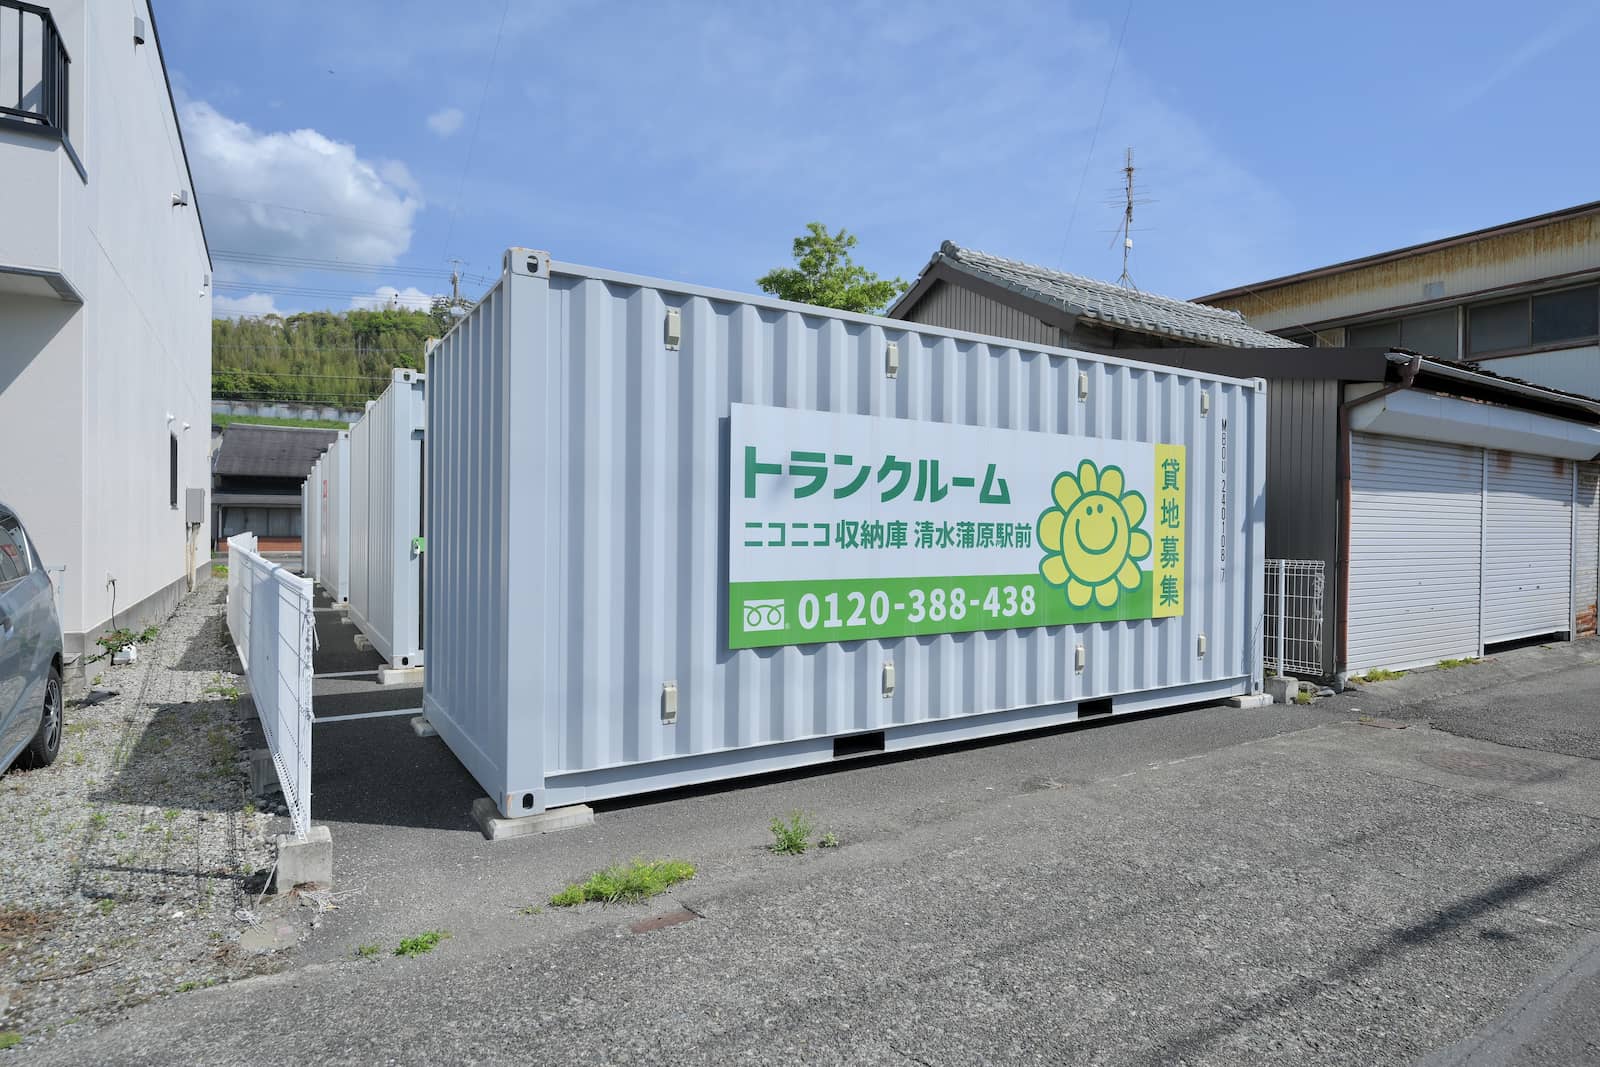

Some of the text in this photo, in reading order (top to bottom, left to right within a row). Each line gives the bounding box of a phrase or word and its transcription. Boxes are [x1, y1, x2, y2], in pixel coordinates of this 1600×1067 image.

[744, 446, 1011, 505] トランクルーム
[744, 519, 1033, 549] ニコニコ収納庫 清水蒲原駅前
[1159, 458, 1180, 607] 貸地募集
[798, 584, 1036, 630] 0120-388-438
